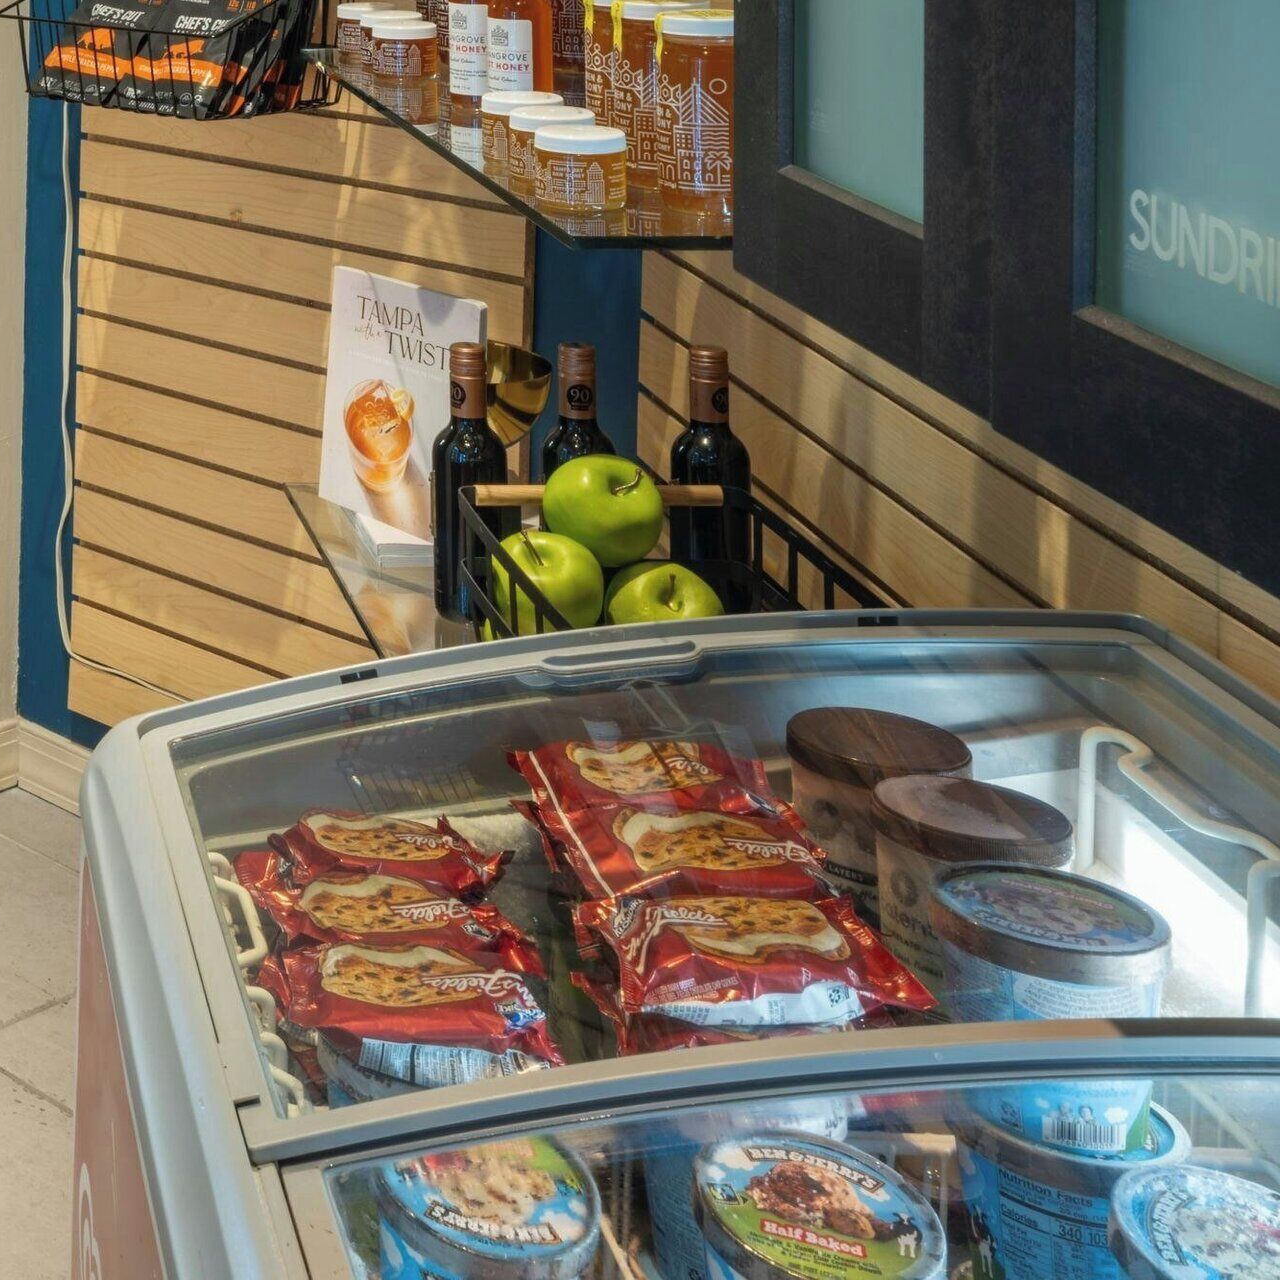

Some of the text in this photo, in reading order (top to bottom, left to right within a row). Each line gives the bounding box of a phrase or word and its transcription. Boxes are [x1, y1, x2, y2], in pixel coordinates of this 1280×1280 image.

[91, 3, 146, 23] CHEF'S CUT
[175, 15, 212, 31] CHEF'S
[456, 45, 488, 54] HONEY
[489, 52, 528, 62] NGROVE
[496, 62, 530, 72] HONEY
[1129, 189, 1280, 308] SUNDRI
[357, 295, 424, 337] TAMPA
[384, 329, 450, 371] TWIST
[569, 387, 590, 402] 90
[388, 898, 464, 924] Fields
[421, 968, 505, 998] Fields
[748, 1147, 787, 1162] BEN
[803, 1154, 878, 1189] JERRY'S
[998, 1168, 1093, 1208] Nutrition Facts
[1000, 1203, 1039, 1228] Calories
[1058, 1224, 1083, 1242] 340
[762, 1219, 802, 1243] Half
[805, 1227, 865, 1258] Baked
